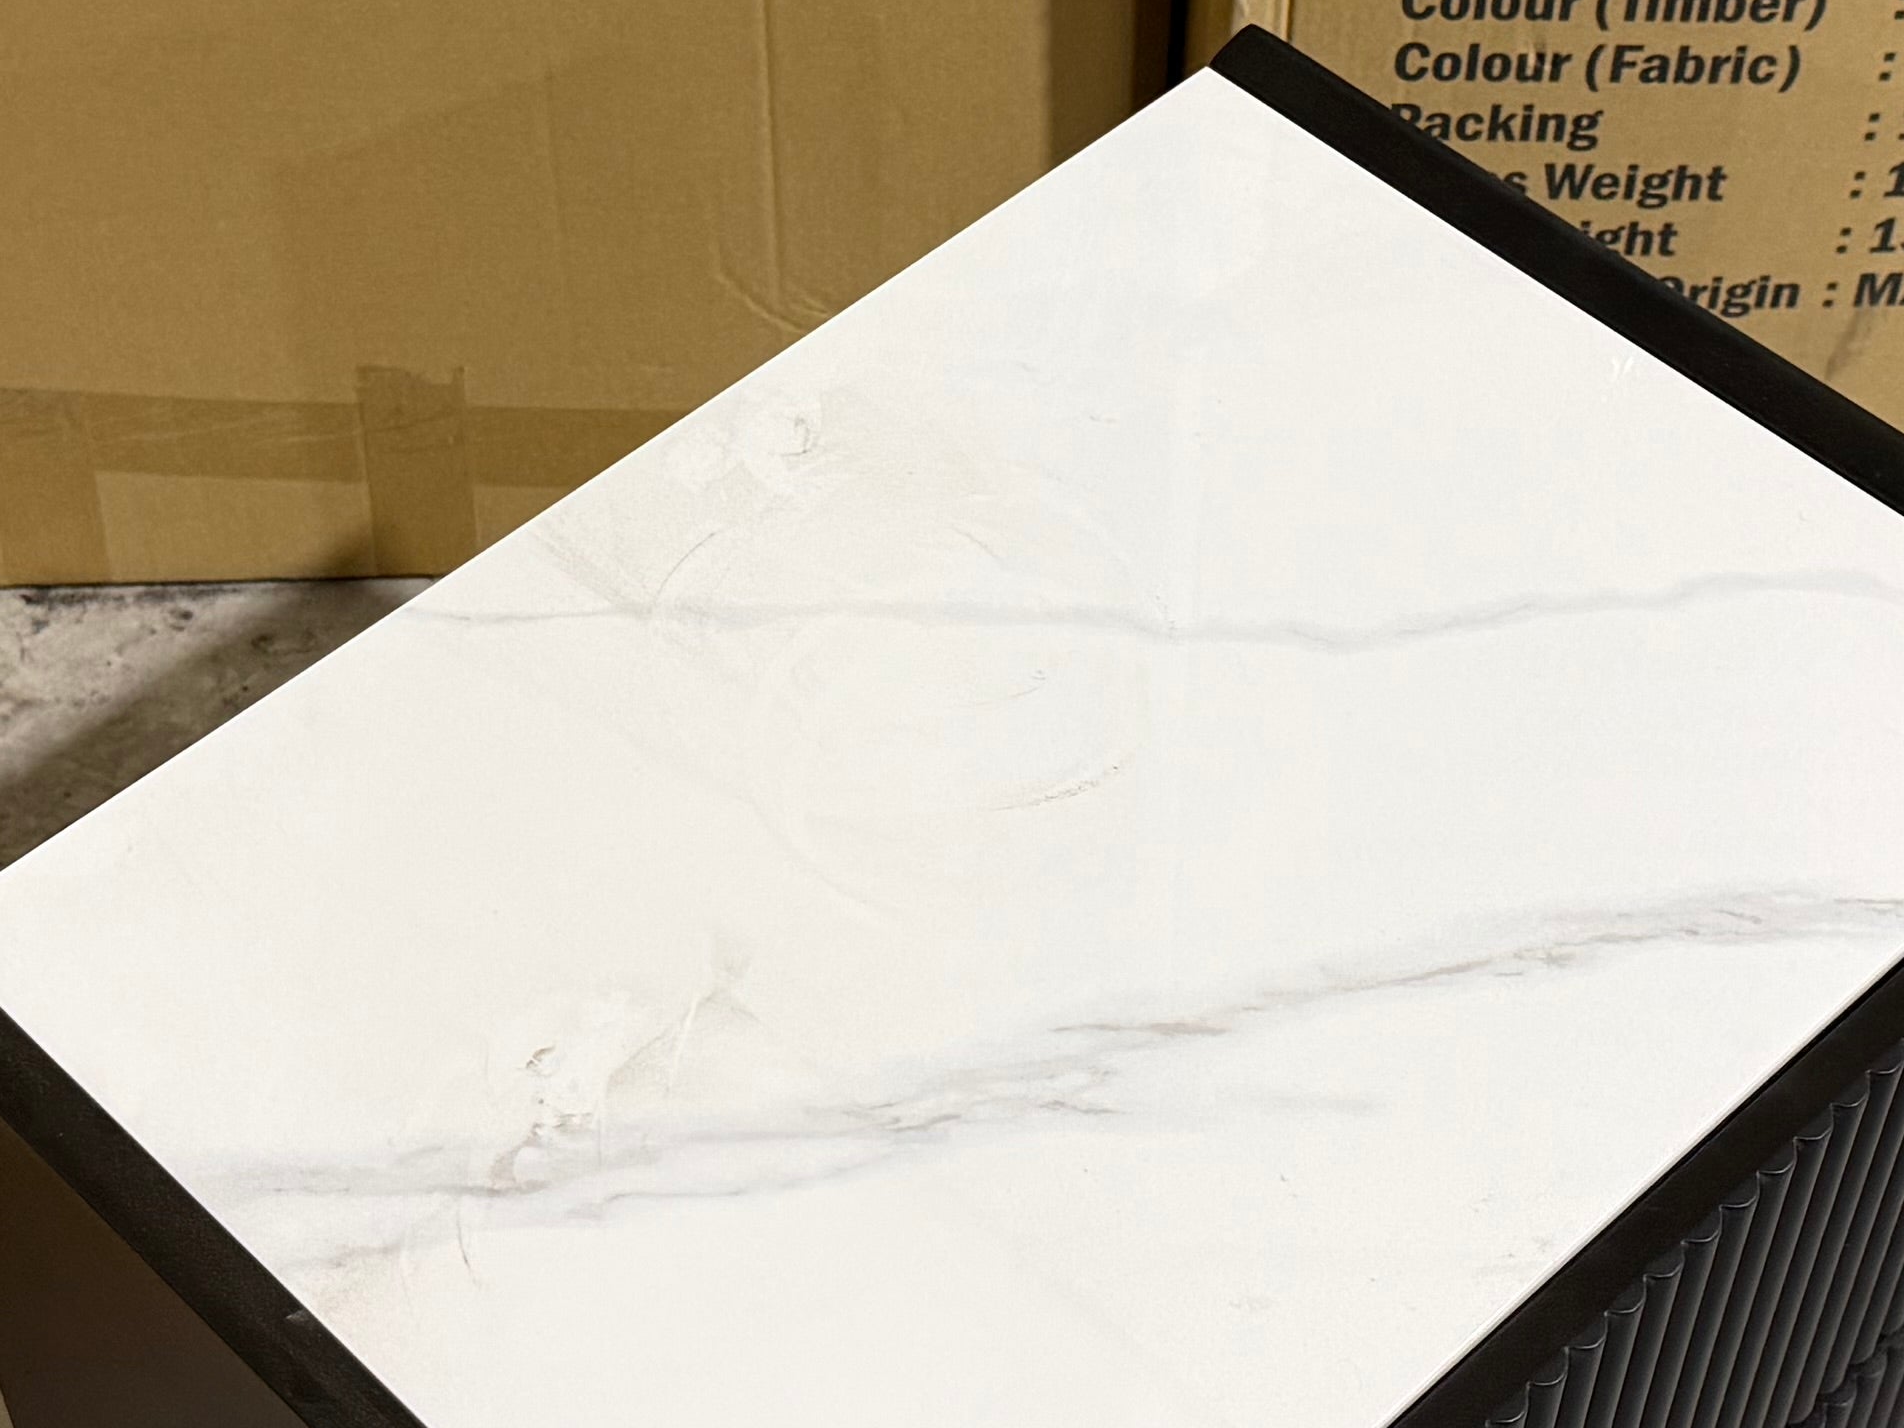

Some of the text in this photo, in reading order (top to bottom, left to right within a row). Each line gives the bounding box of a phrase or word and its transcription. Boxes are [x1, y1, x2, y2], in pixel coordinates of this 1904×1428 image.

[1394, 41, 1573, 84] Colour
[1584, 43, 1801, 94] (Fabric)
[1544, 162, 1728, 210] Weight
